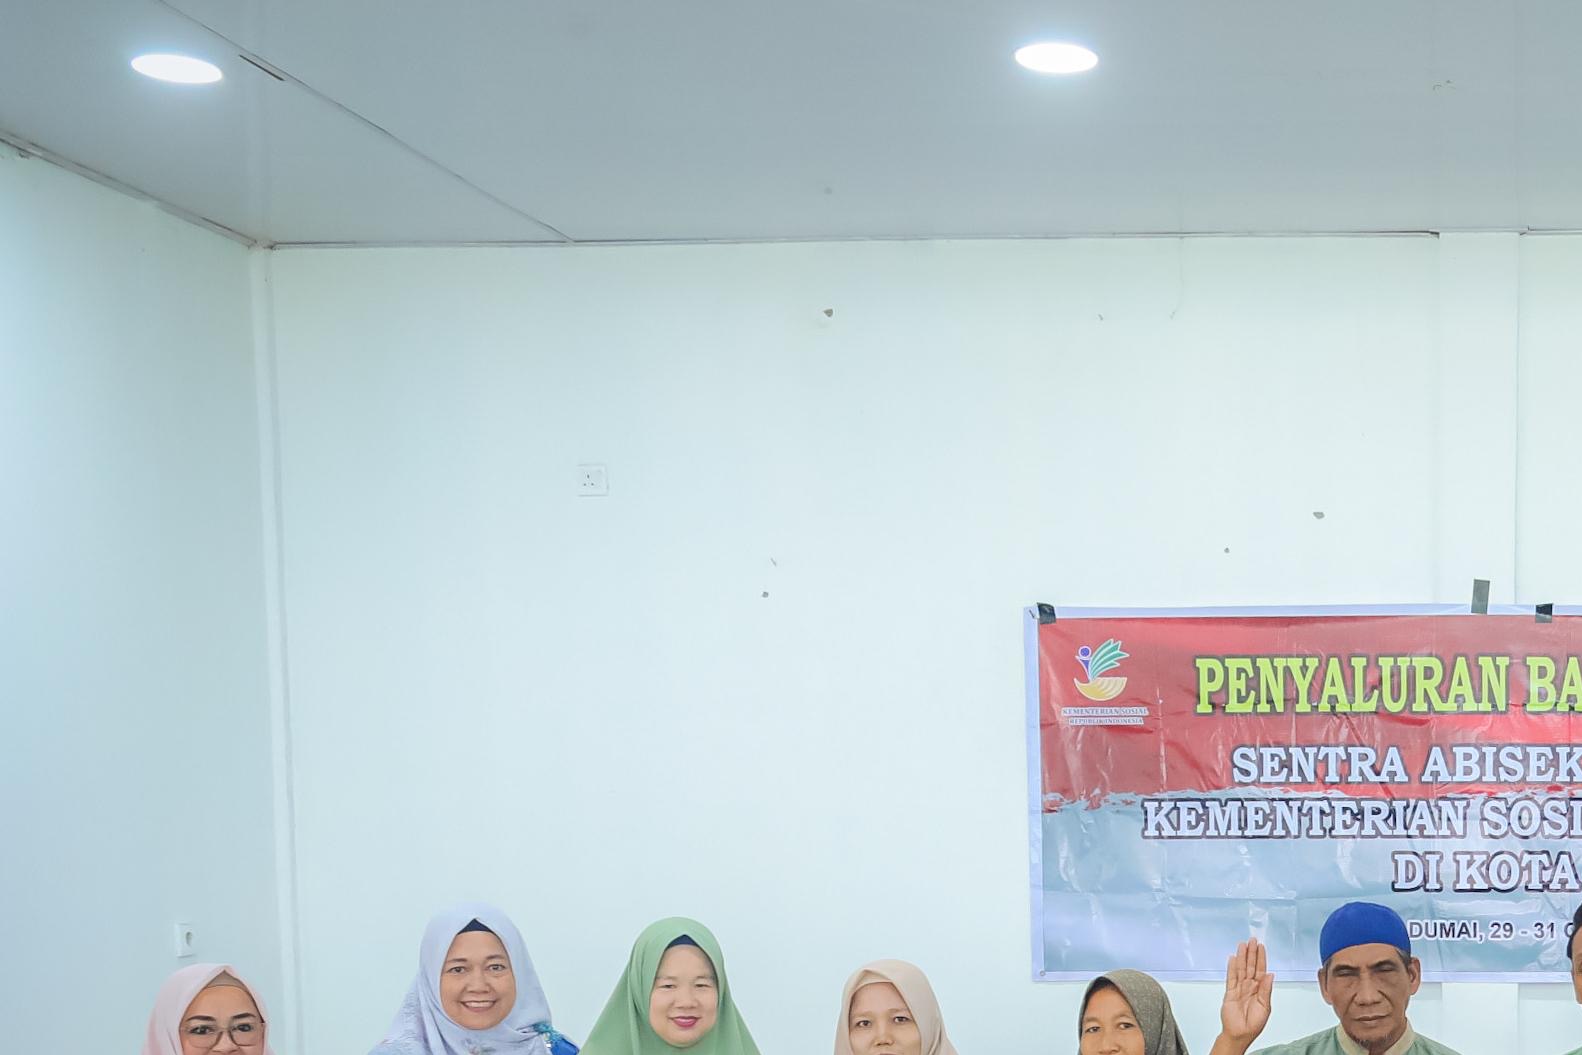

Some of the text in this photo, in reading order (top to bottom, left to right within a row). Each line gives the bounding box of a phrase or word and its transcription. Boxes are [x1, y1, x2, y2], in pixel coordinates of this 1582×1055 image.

[1194, 655, 1511, 714] PENYALURAN
[1230, 745, 1409, 785] SENTRA
[1142, 798, 1469, 839] KEMENTERIAN
[1391, 851, 1444, 893] DI
[1408, 922, 1483, 941] DUMAI,
[1490, 922, 1514, 940] 29
[1533, 922, 1556, 940] 31
